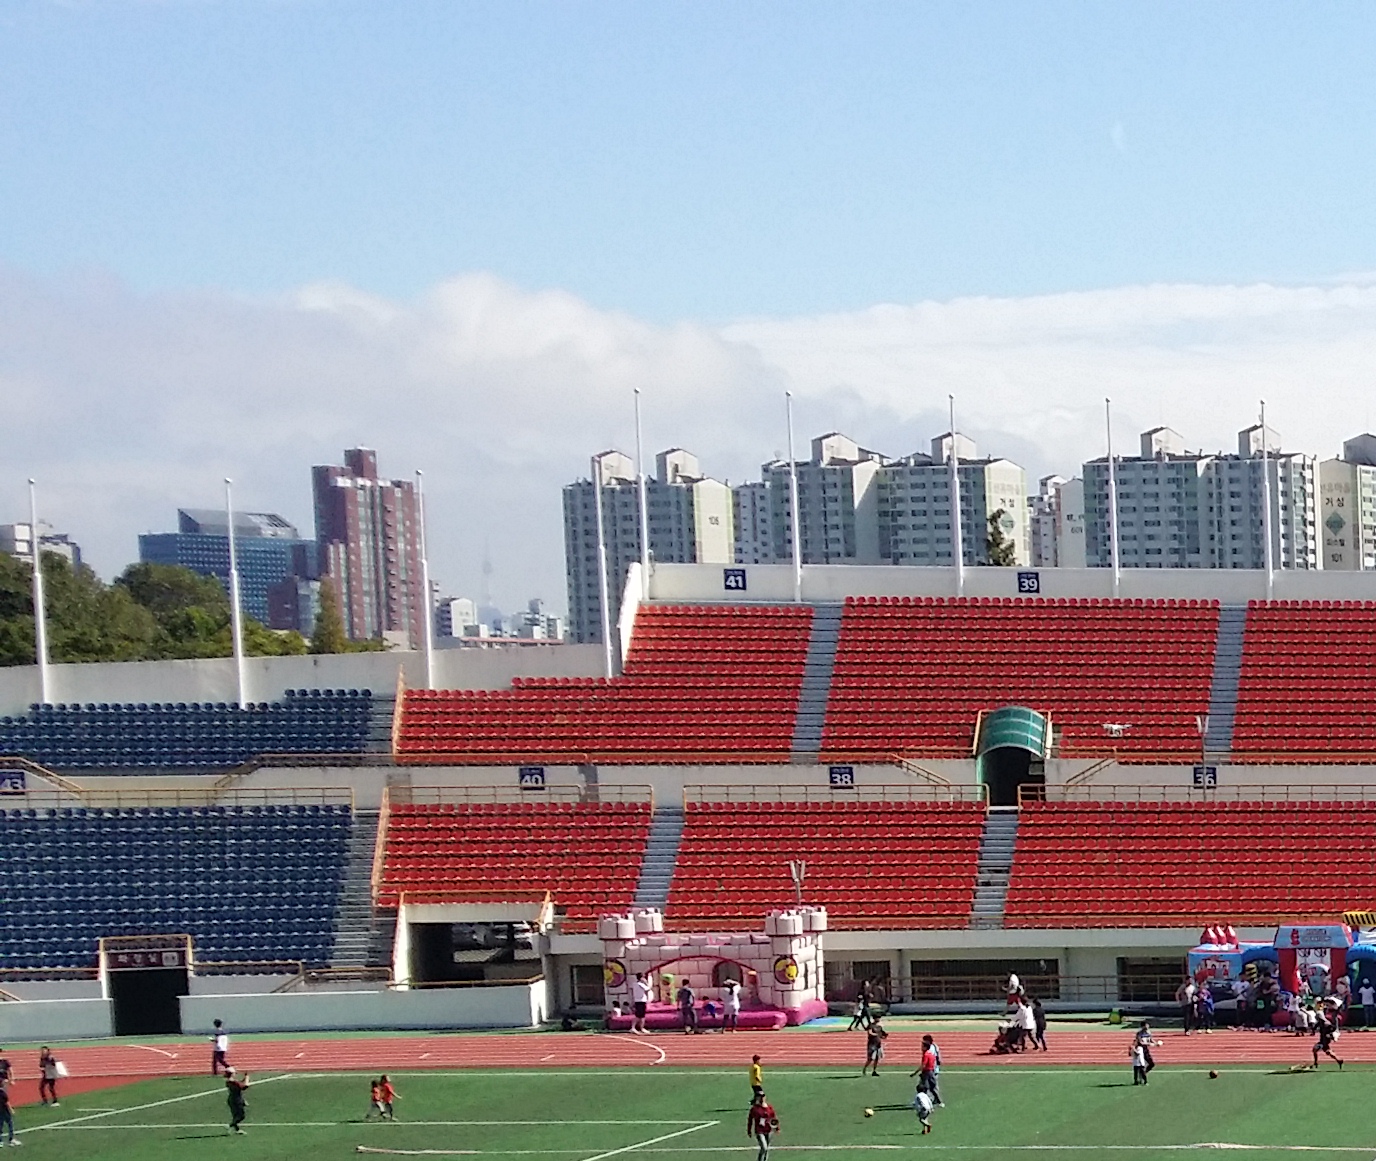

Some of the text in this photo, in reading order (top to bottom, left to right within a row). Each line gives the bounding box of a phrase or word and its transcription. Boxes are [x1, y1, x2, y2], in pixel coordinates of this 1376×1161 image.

[726, 576, 743, 588] 41
[1020, 578, 1038, 591] 39
[523, 775, 541, 786] 40
[831, 774, 851, 785] 38
[1196, 774, 1214, 786] 36
